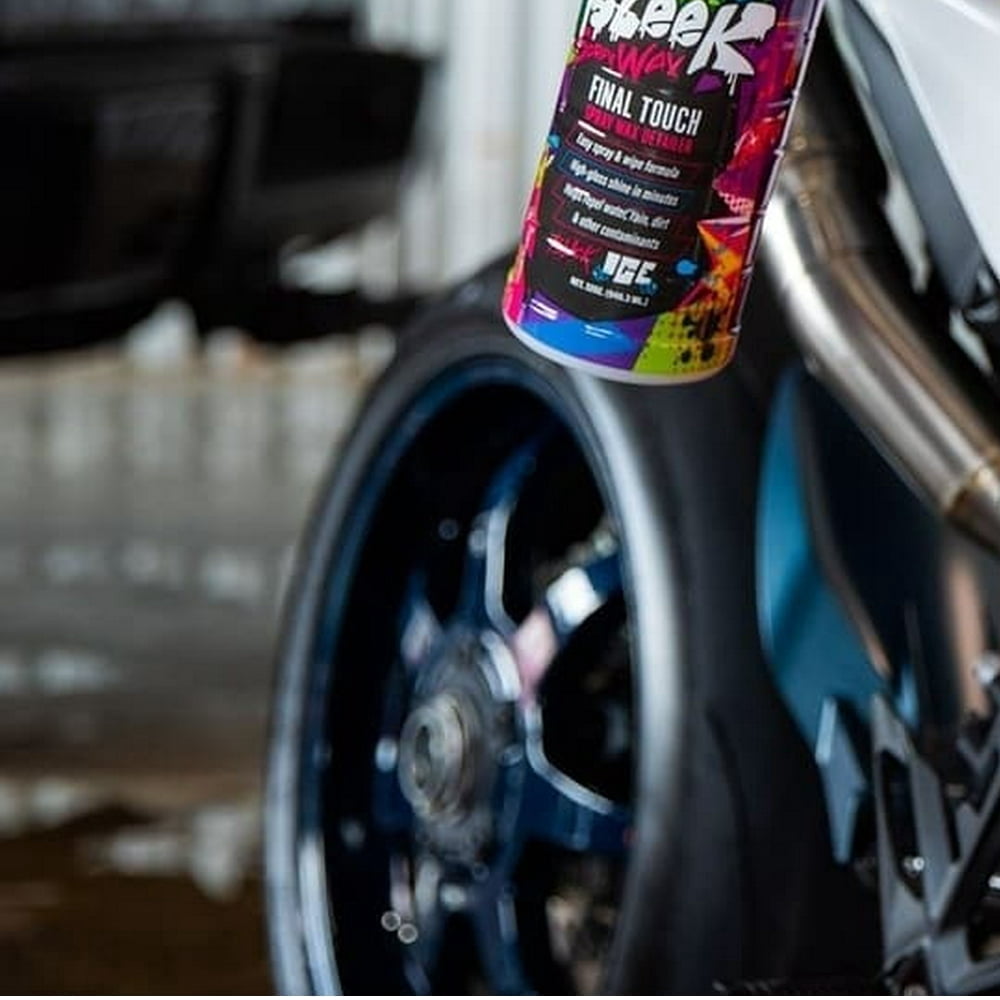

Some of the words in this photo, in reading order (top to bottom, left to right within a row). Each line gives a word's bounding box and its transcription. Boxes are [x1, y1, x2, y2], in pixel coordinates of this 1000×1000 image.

[588, 74, 633, 119] FINAL
[639, 95, 703, 136] TOUCH
[592, 142, 614, 161] spray
[622, 154, 644, 170] wipe
[643, 160, 680, 179] formula
[607, 177, 632, 195] shine
[641, 189, 679, 206] minutes
